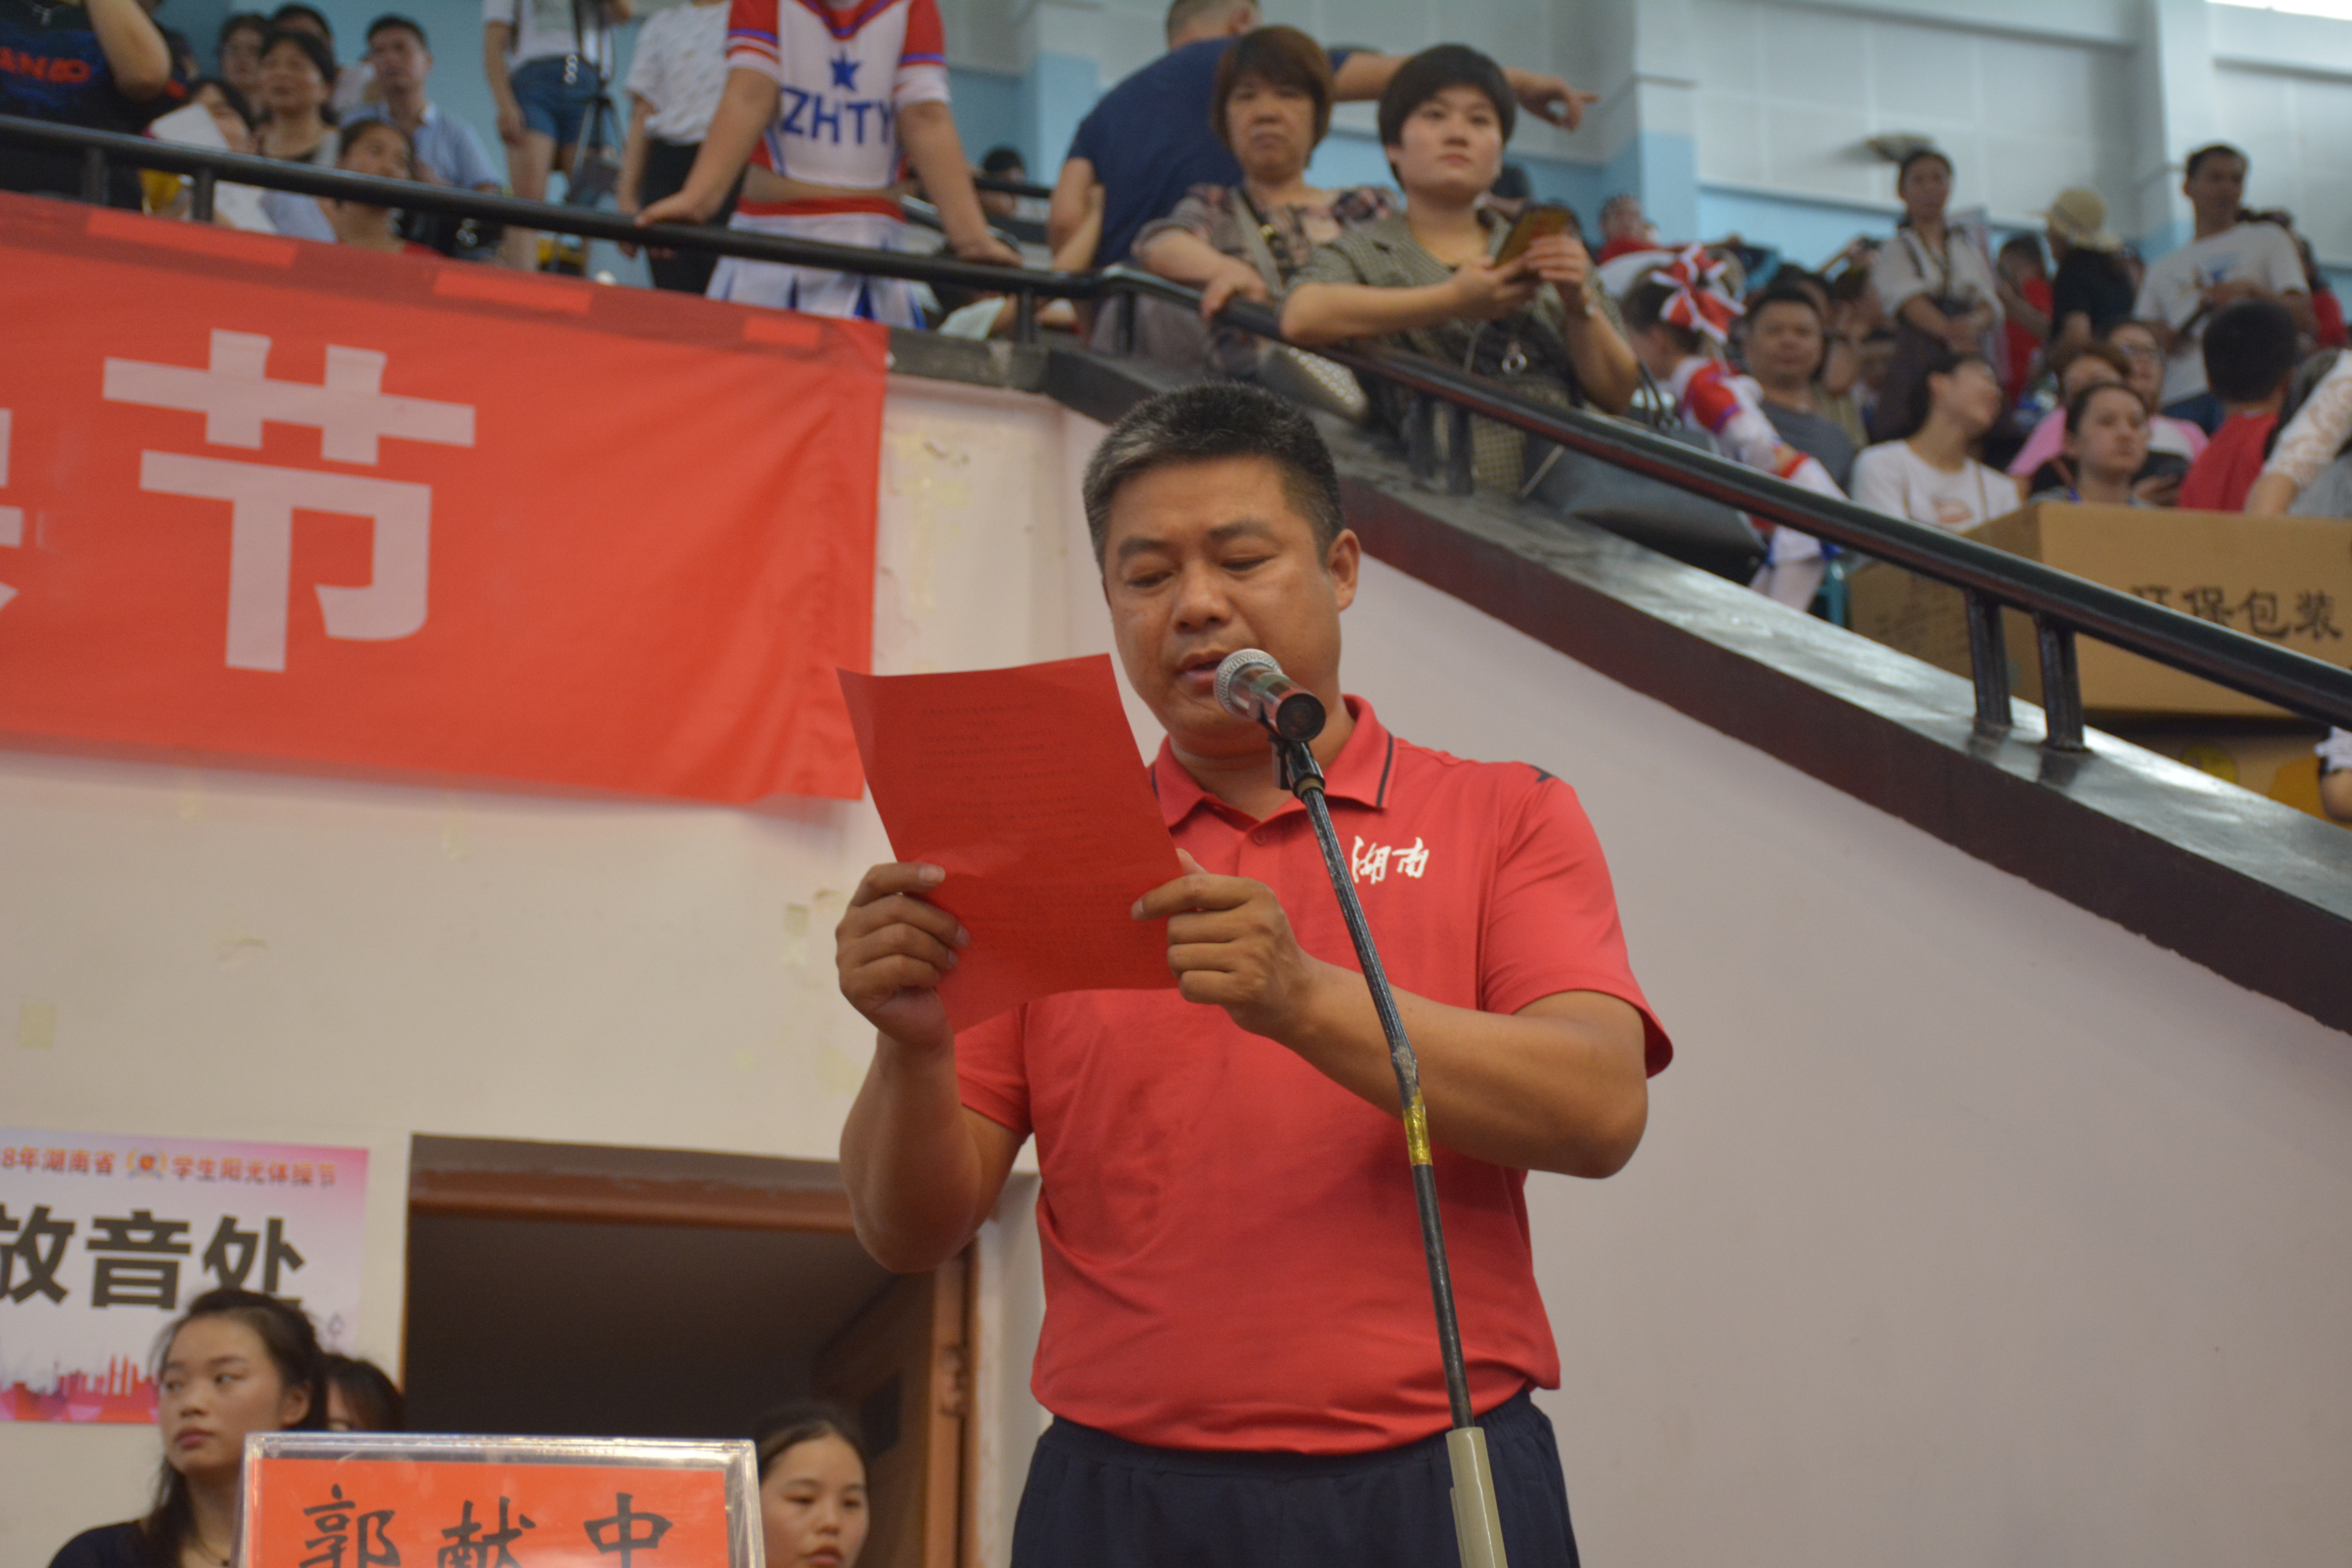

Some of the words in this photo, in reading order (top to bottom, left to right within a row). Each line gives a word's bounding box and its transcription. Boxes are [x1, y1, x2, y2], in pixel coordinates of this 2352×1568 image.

[780, 85, 892, 144] ZHTY
[0, 328, 476, 673] 节
[1352, 835, 1430, 885] 湖南
[0, 1203, 306, 1310] 放音处
